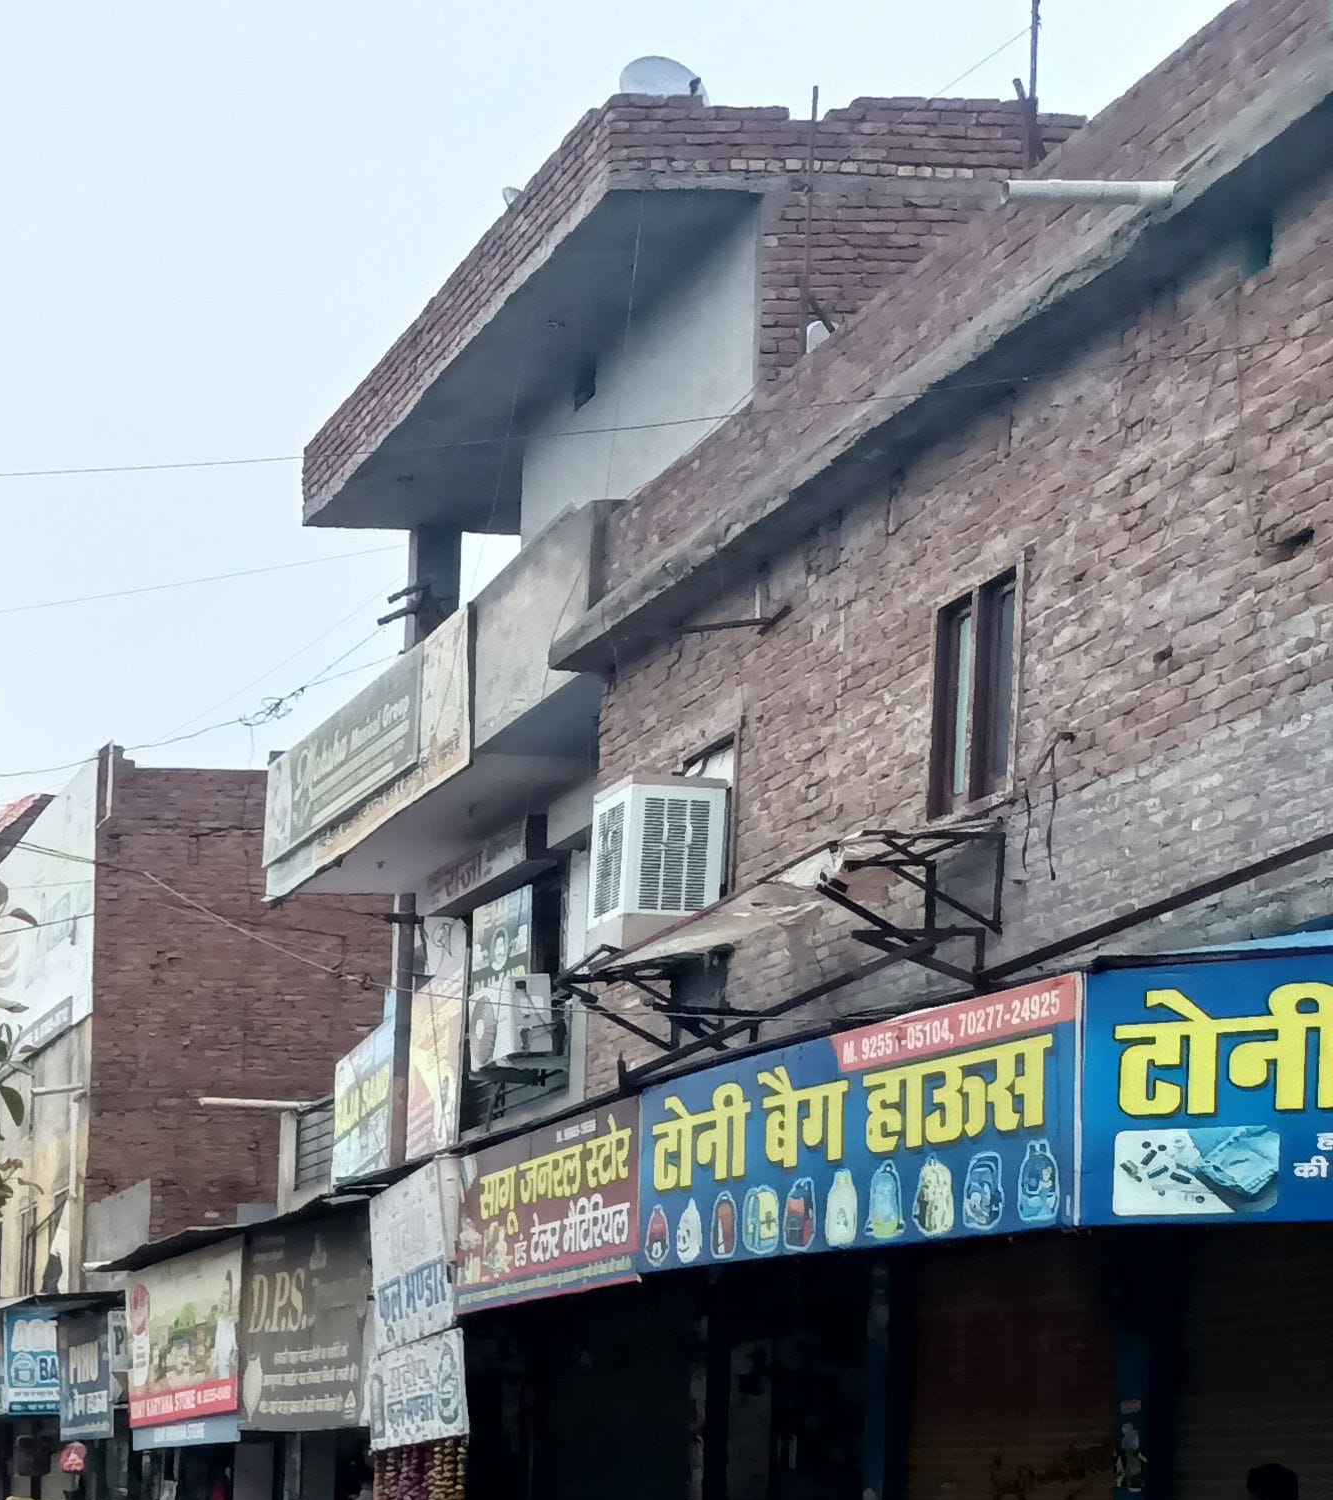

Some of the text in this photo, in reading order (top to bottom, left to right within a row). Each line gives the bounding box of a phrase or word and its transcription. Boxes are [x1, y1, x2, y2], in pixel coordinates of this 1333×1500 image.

[842, 1042, 858, 1064] M.
[958, 989, 1060, 1038] 70277-24925
[1114, 981, 1333, 1116] टोनी
[651, 1033, 1054, 1193] टोनी बैग हाऊस
[479, 1113, 633, 1236] सागू जनरल स्टोर
[1293, 1155, 1330, 1180] की
[529, 1212, 562, 1263] टेलर
[247, 1268, 308, 1334] D.P.S.
[405, 1254, 447, 1313] भण्डार
